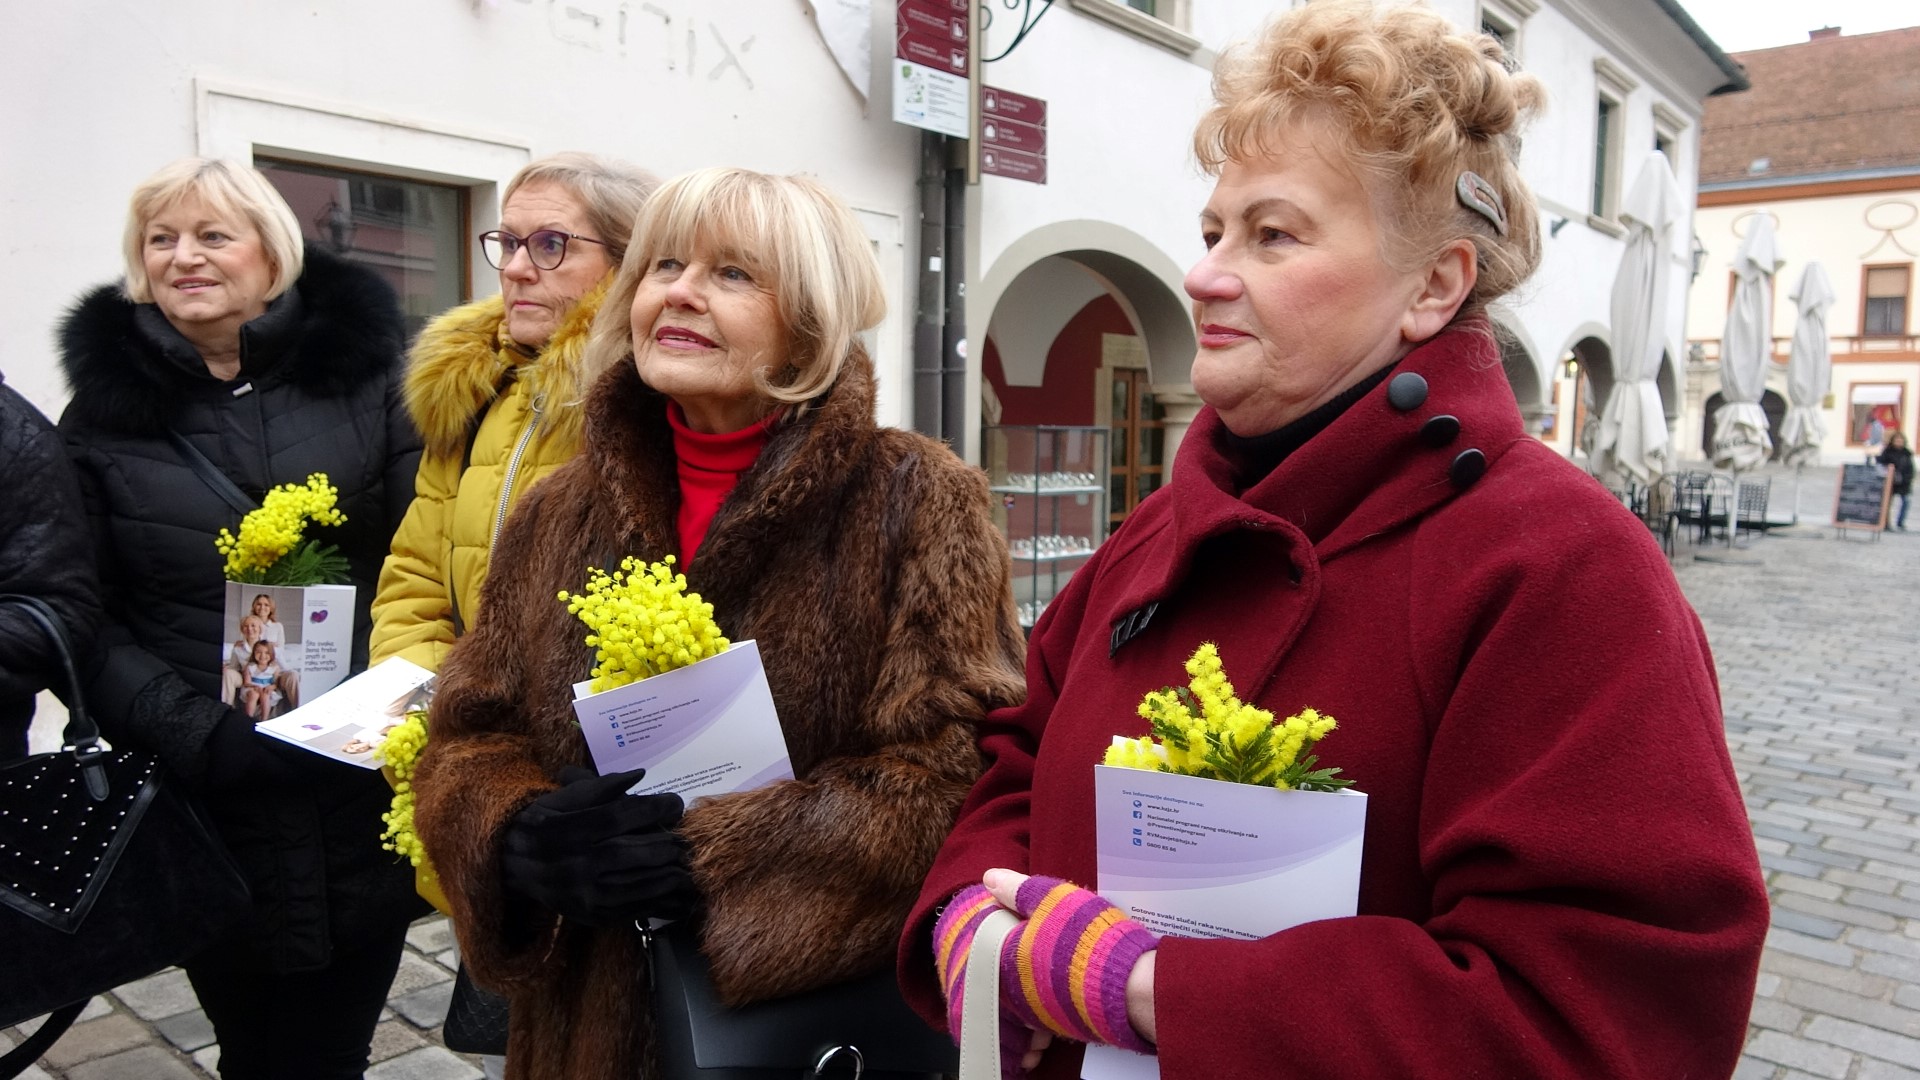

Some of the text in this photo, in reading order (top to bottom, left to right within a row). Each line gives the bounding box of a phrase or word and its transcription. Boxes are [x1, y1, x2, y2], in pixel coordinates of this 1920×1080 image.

[1176, 820, 1200, 828] programi
[1131, 906, 1156, 916] Gotovo
[1176, 916, 1197, 926] slučaj
[1215, 926, 1234, 934] vrata
[1160, 921, 1190, 932] spriječiti
